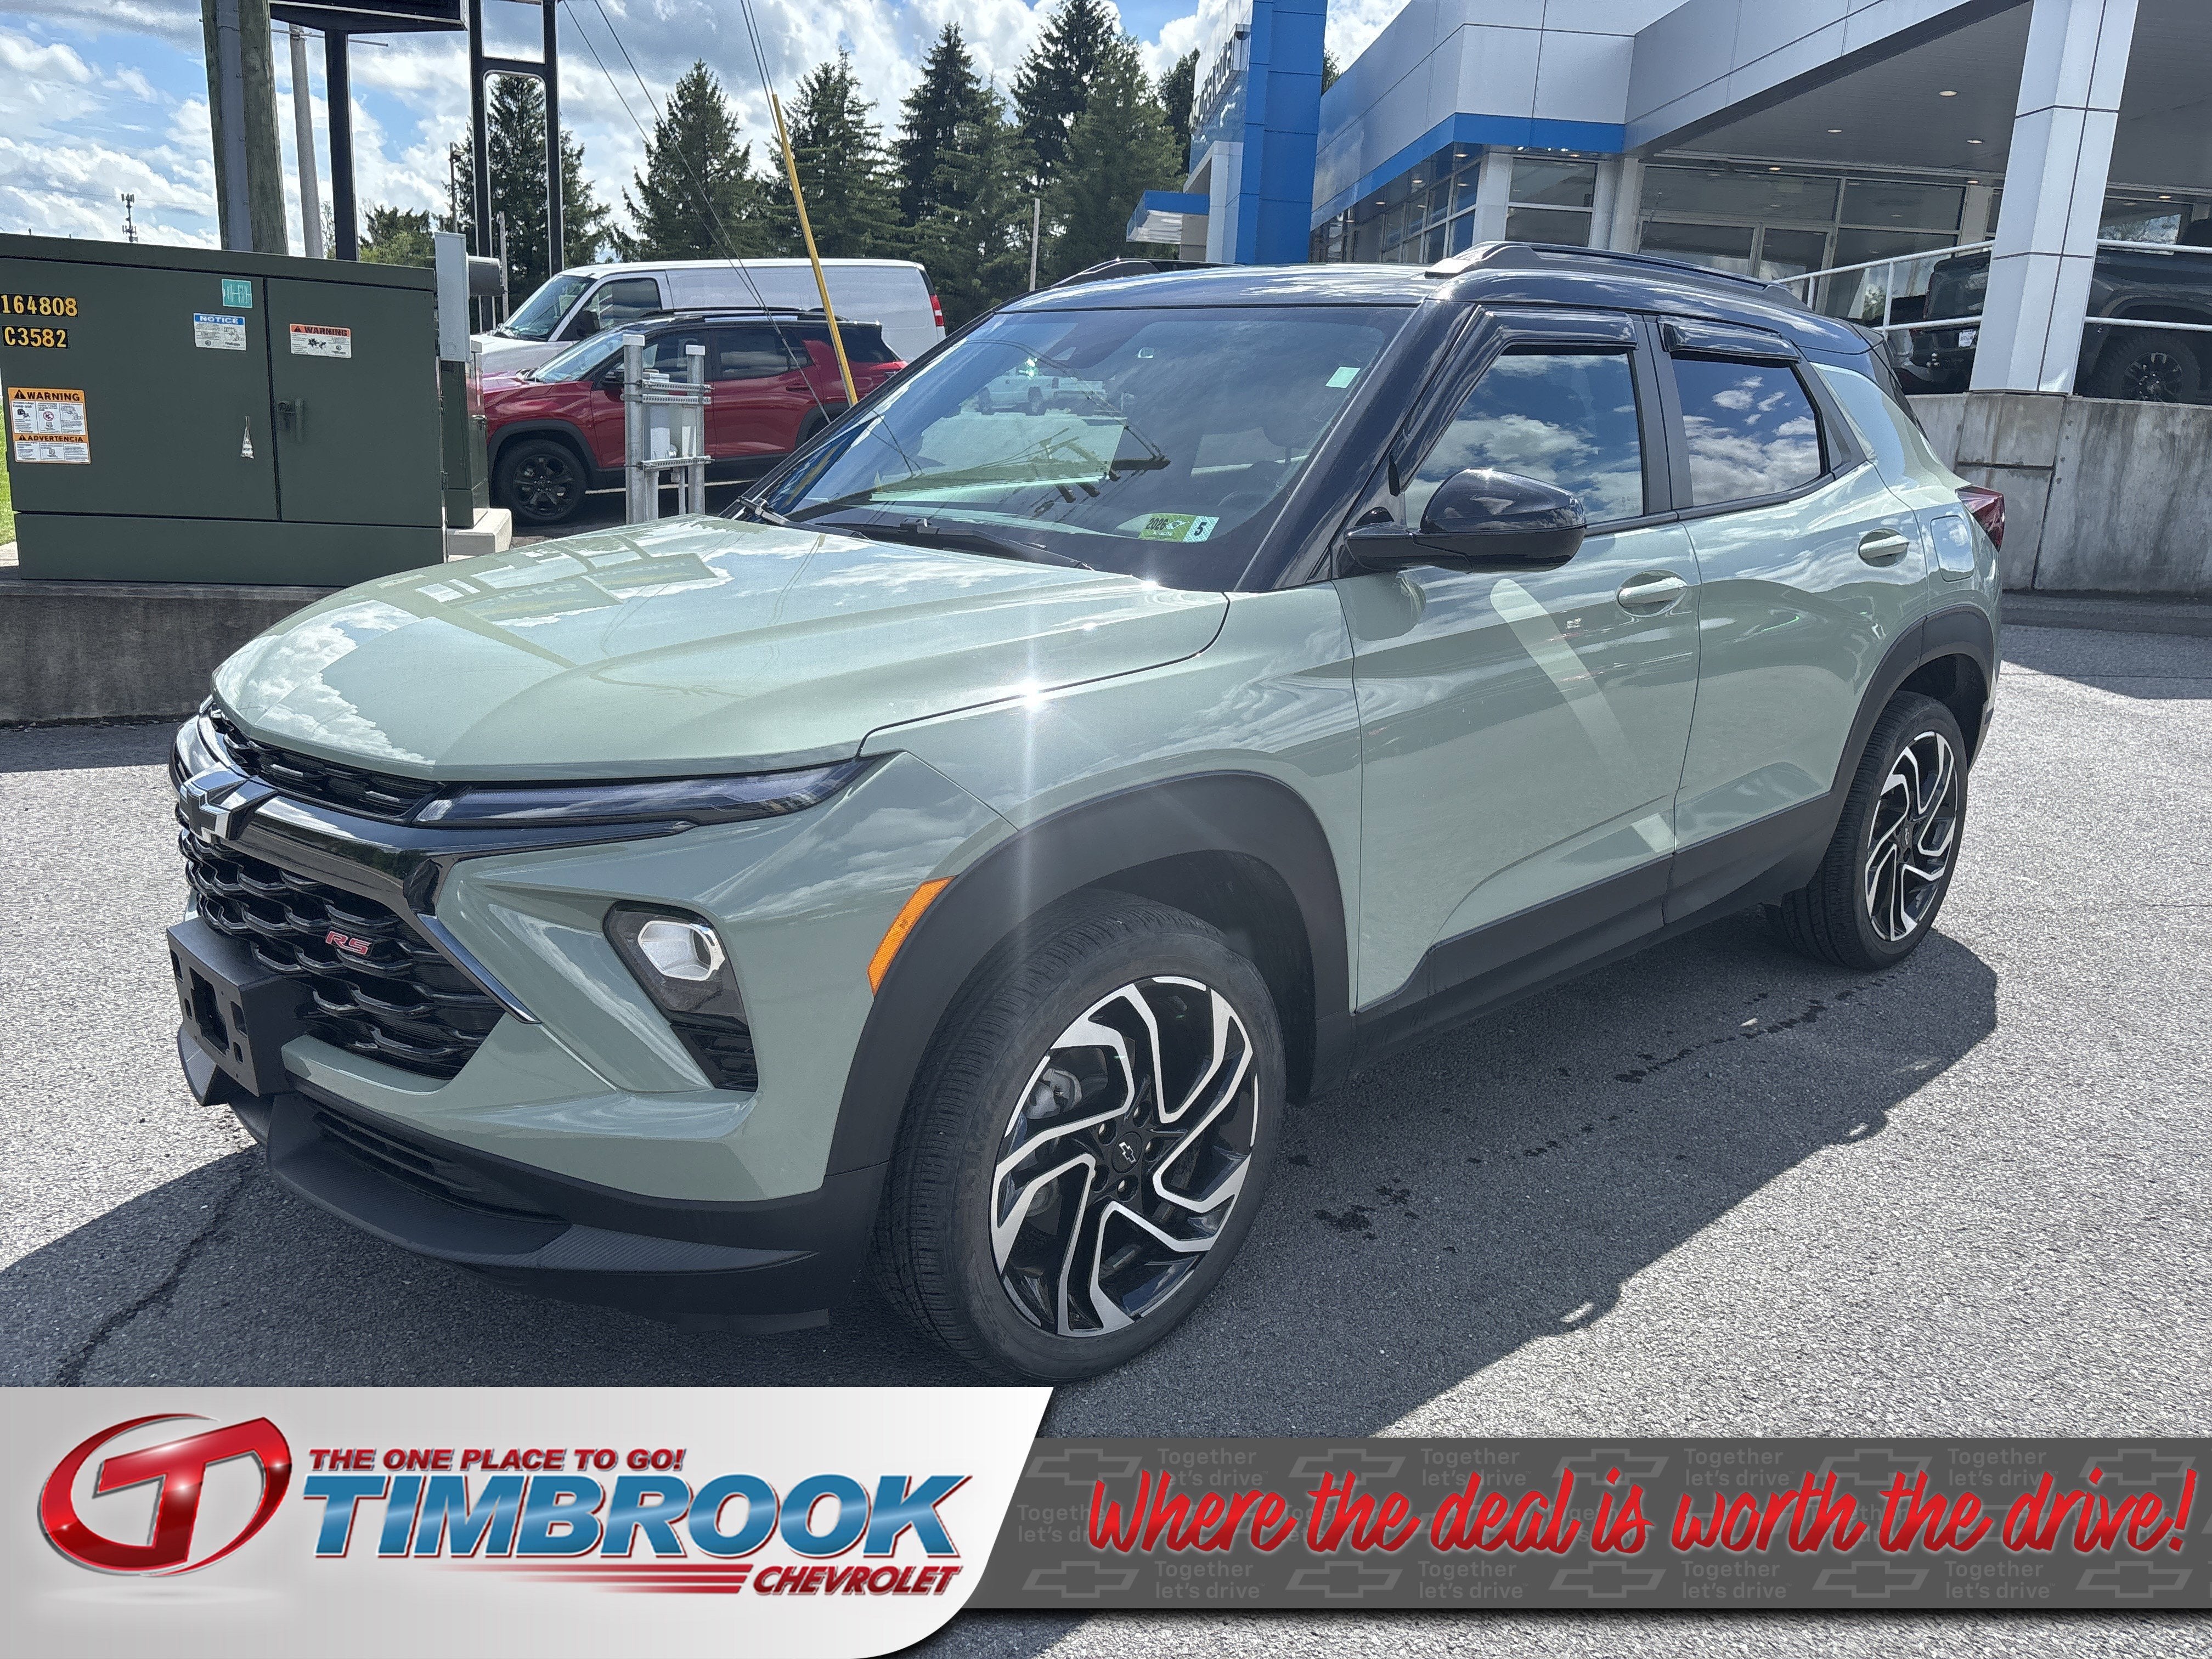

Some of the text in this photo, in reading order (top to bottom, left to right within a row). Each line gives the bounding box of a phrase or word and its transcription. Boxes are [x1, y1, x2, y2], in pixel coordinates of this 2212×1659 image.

[1, 294, 77, 317] 164808
[199, 315, 239, 324] NOTICE
[4, 326, 67, 348] C3582
[304, 326, 347, 336] WARNING
[26, 391, 80, 401] WARNING
[1145, 517, 1207, 536] 2026 5
[325, 930, 373, 955] RS
